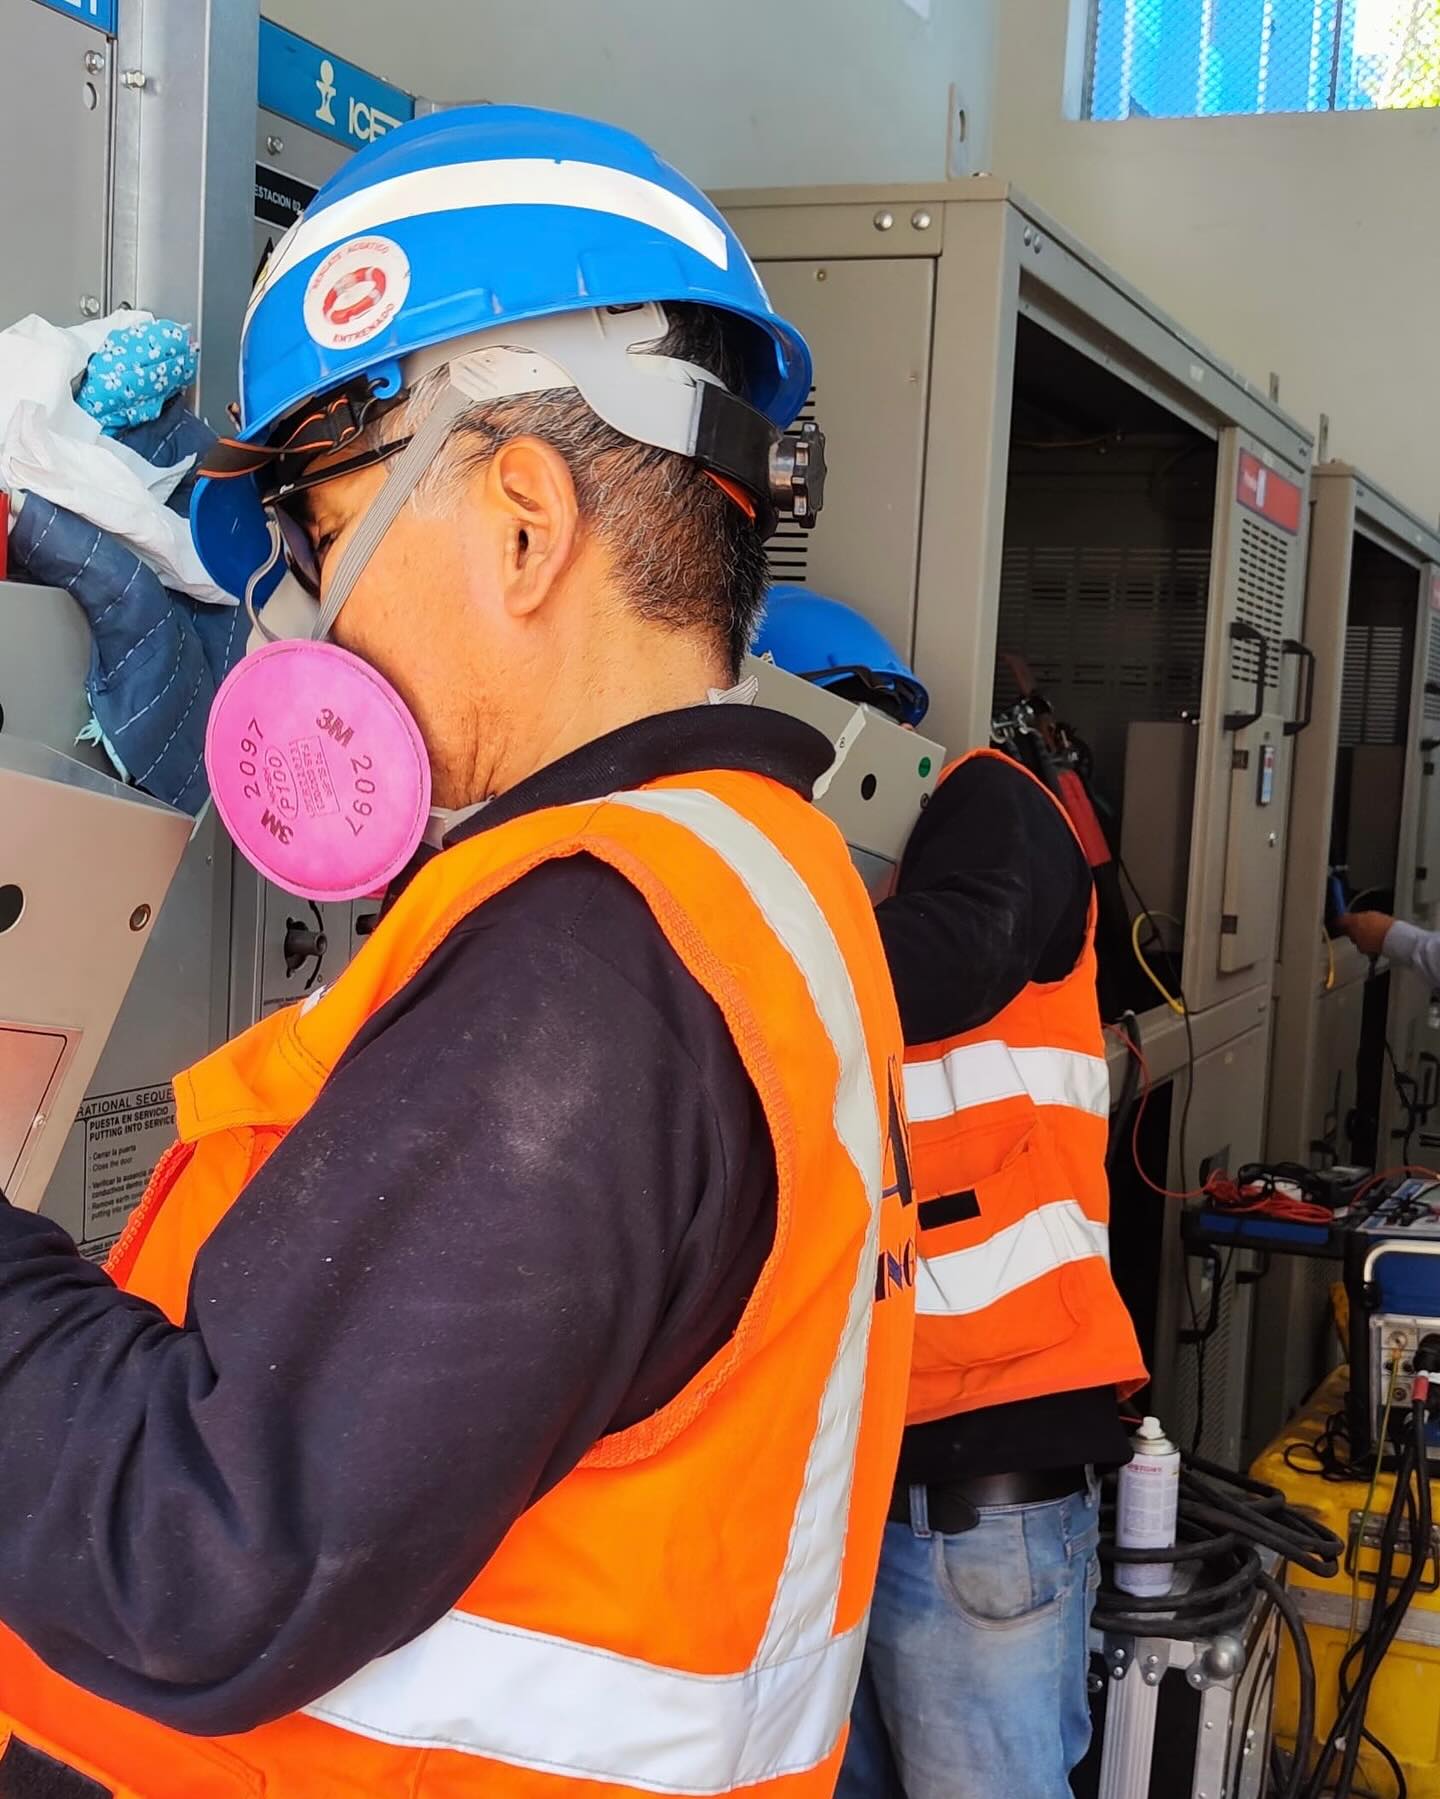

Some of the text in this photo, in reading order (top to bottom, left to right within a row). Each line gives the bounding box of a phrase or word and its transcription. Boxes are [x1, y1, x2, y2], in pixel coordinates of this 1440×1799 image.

[239, 716, 294, 846] 3M 2097
[268, 756, 296, 811] P100
[315, 708, 355, 749] 3M
[345, 754, 375, 837] 2097
[89, 1106, 168, 1130] PUESTA EN SERVICIO
[89, 1115, 175, 1142] PUTTING INTO SERVICE
